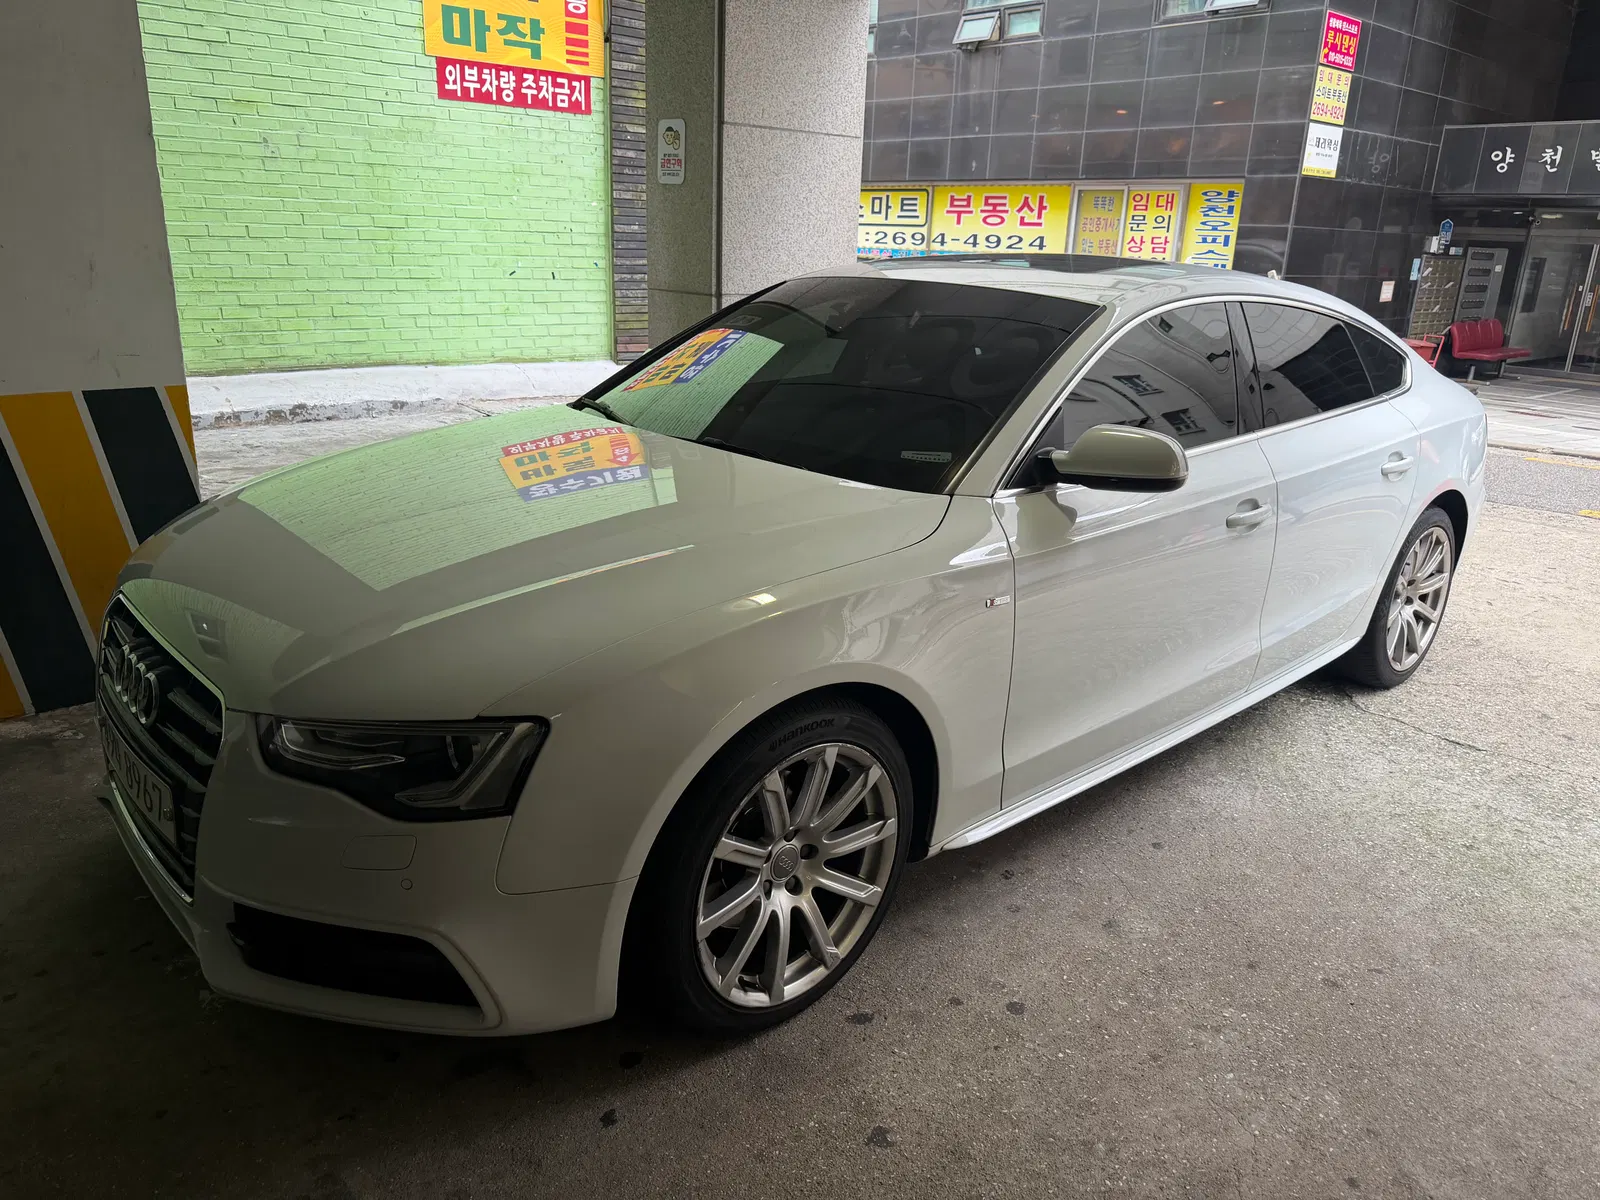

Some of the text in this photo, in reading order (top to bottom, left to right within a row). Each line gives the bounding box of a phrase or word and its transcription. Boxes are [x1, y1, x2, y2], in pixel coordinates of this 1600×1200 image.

[441, 4, 545, 60] 마작
[444, 63, 586, 111] 외부차량 주차금지
[661, 158, 682, 169] 금연구역
[946, 194, 1048, 227] 부동산
[1132, 193, 1175, 212] 임대
[1129, 214, 1171, 233] 문의
[1192, 190, 1240, 269] 양천오피스
[1127, 235, 1170, 254] 상담
